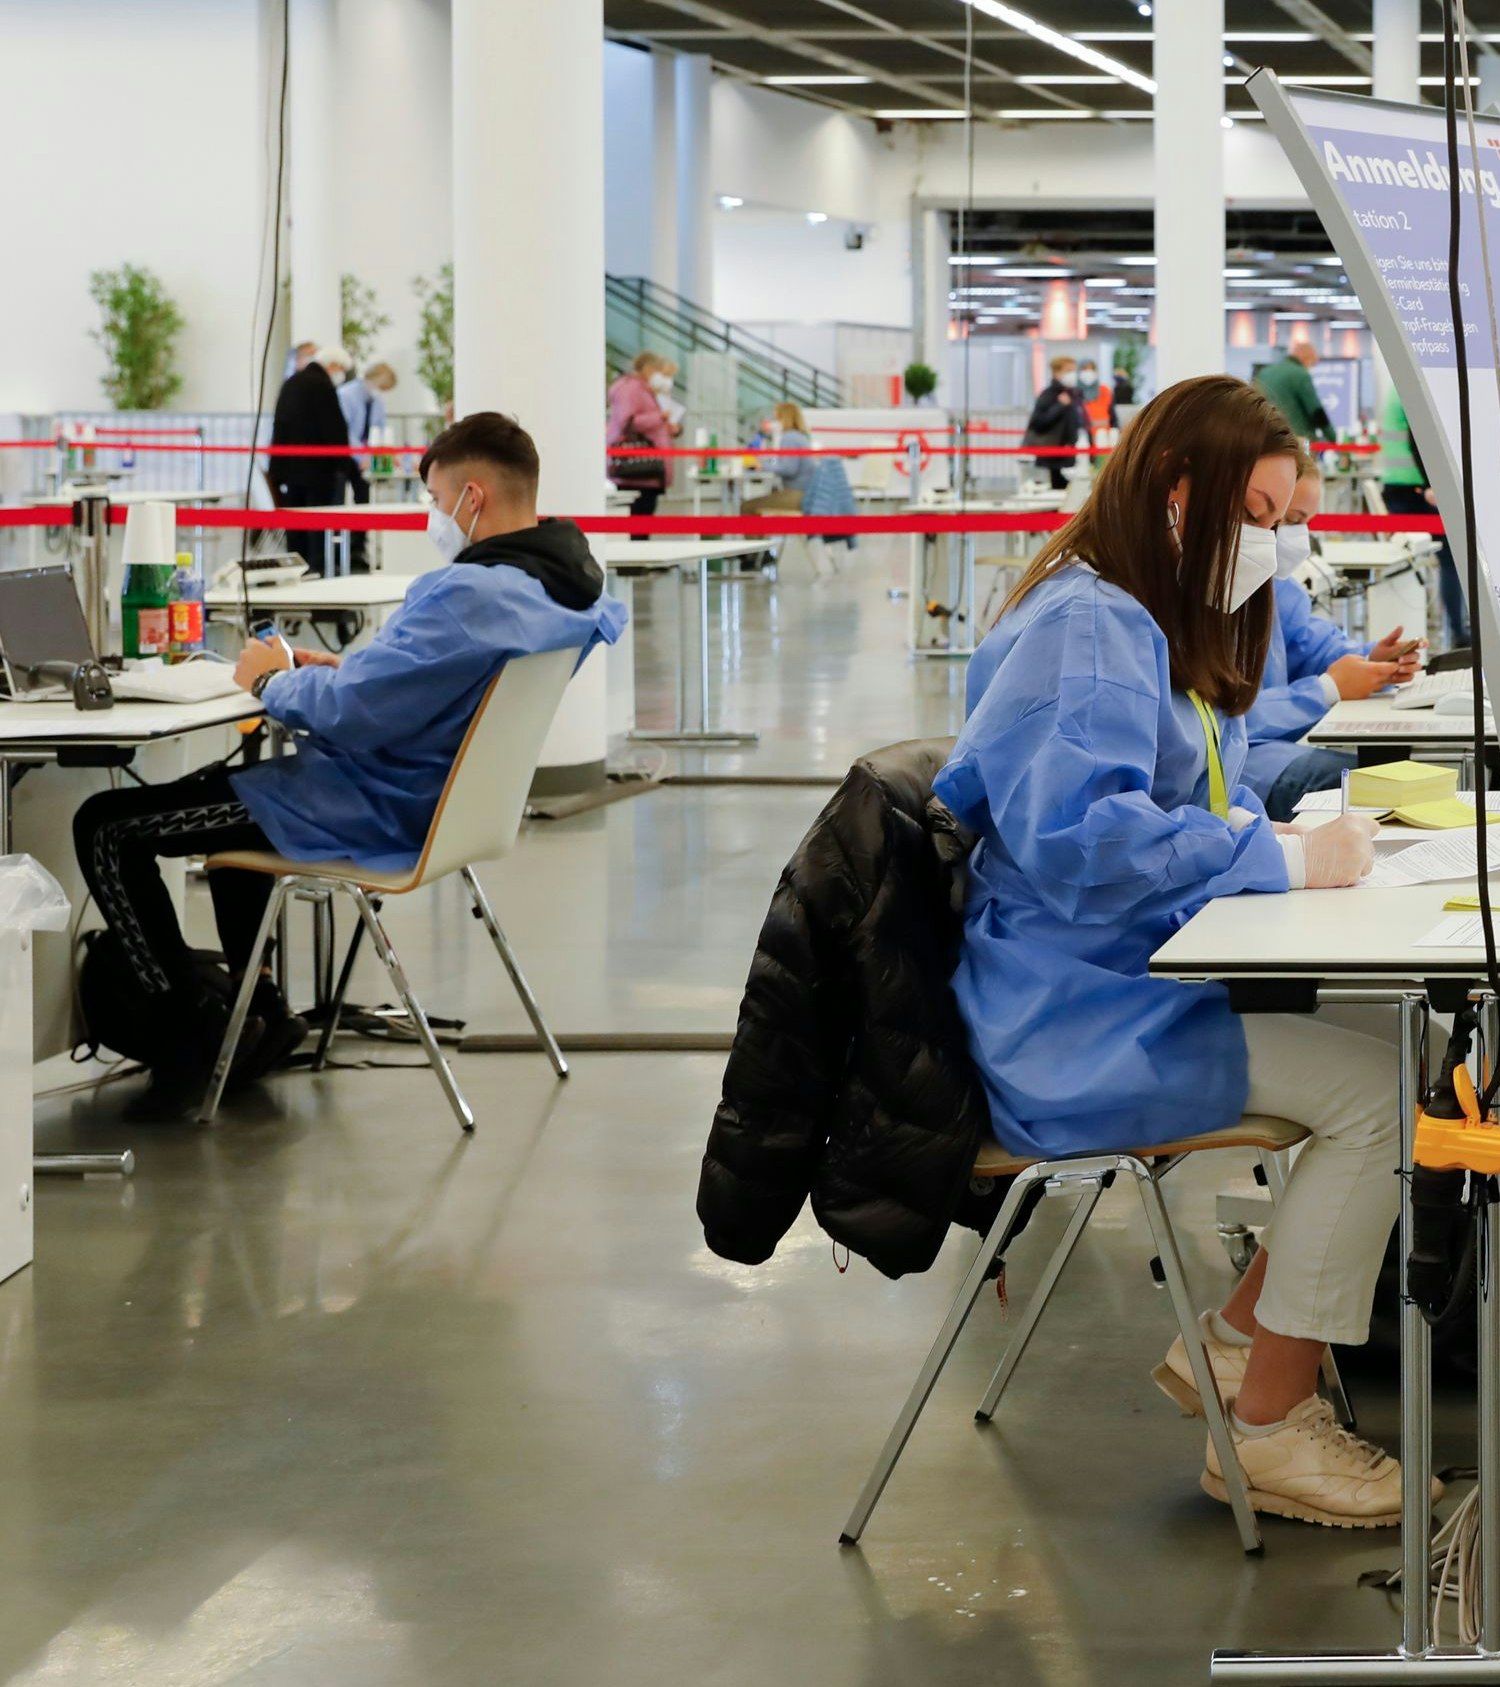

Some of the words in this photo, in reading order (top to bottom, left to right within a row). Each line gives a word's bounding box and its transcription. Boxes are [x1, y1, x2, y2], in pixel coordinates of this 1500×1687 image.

[1353, 209, 1400, 230] tation
[1398, 210, 1412, 230] 2
[1373, 254, 1398, 272] igen
[1397, 255, 1415, 271] Sie
[1414, 259, 1433, 271] uns
[1431, 257, 1449, 272] bitt
[1382, 275, 1470, 296] Terminbestätigng
[1402, 317, 1479, 337] mpf-Fragebgen
[1411, 338, 1450, 356] mpfpass
